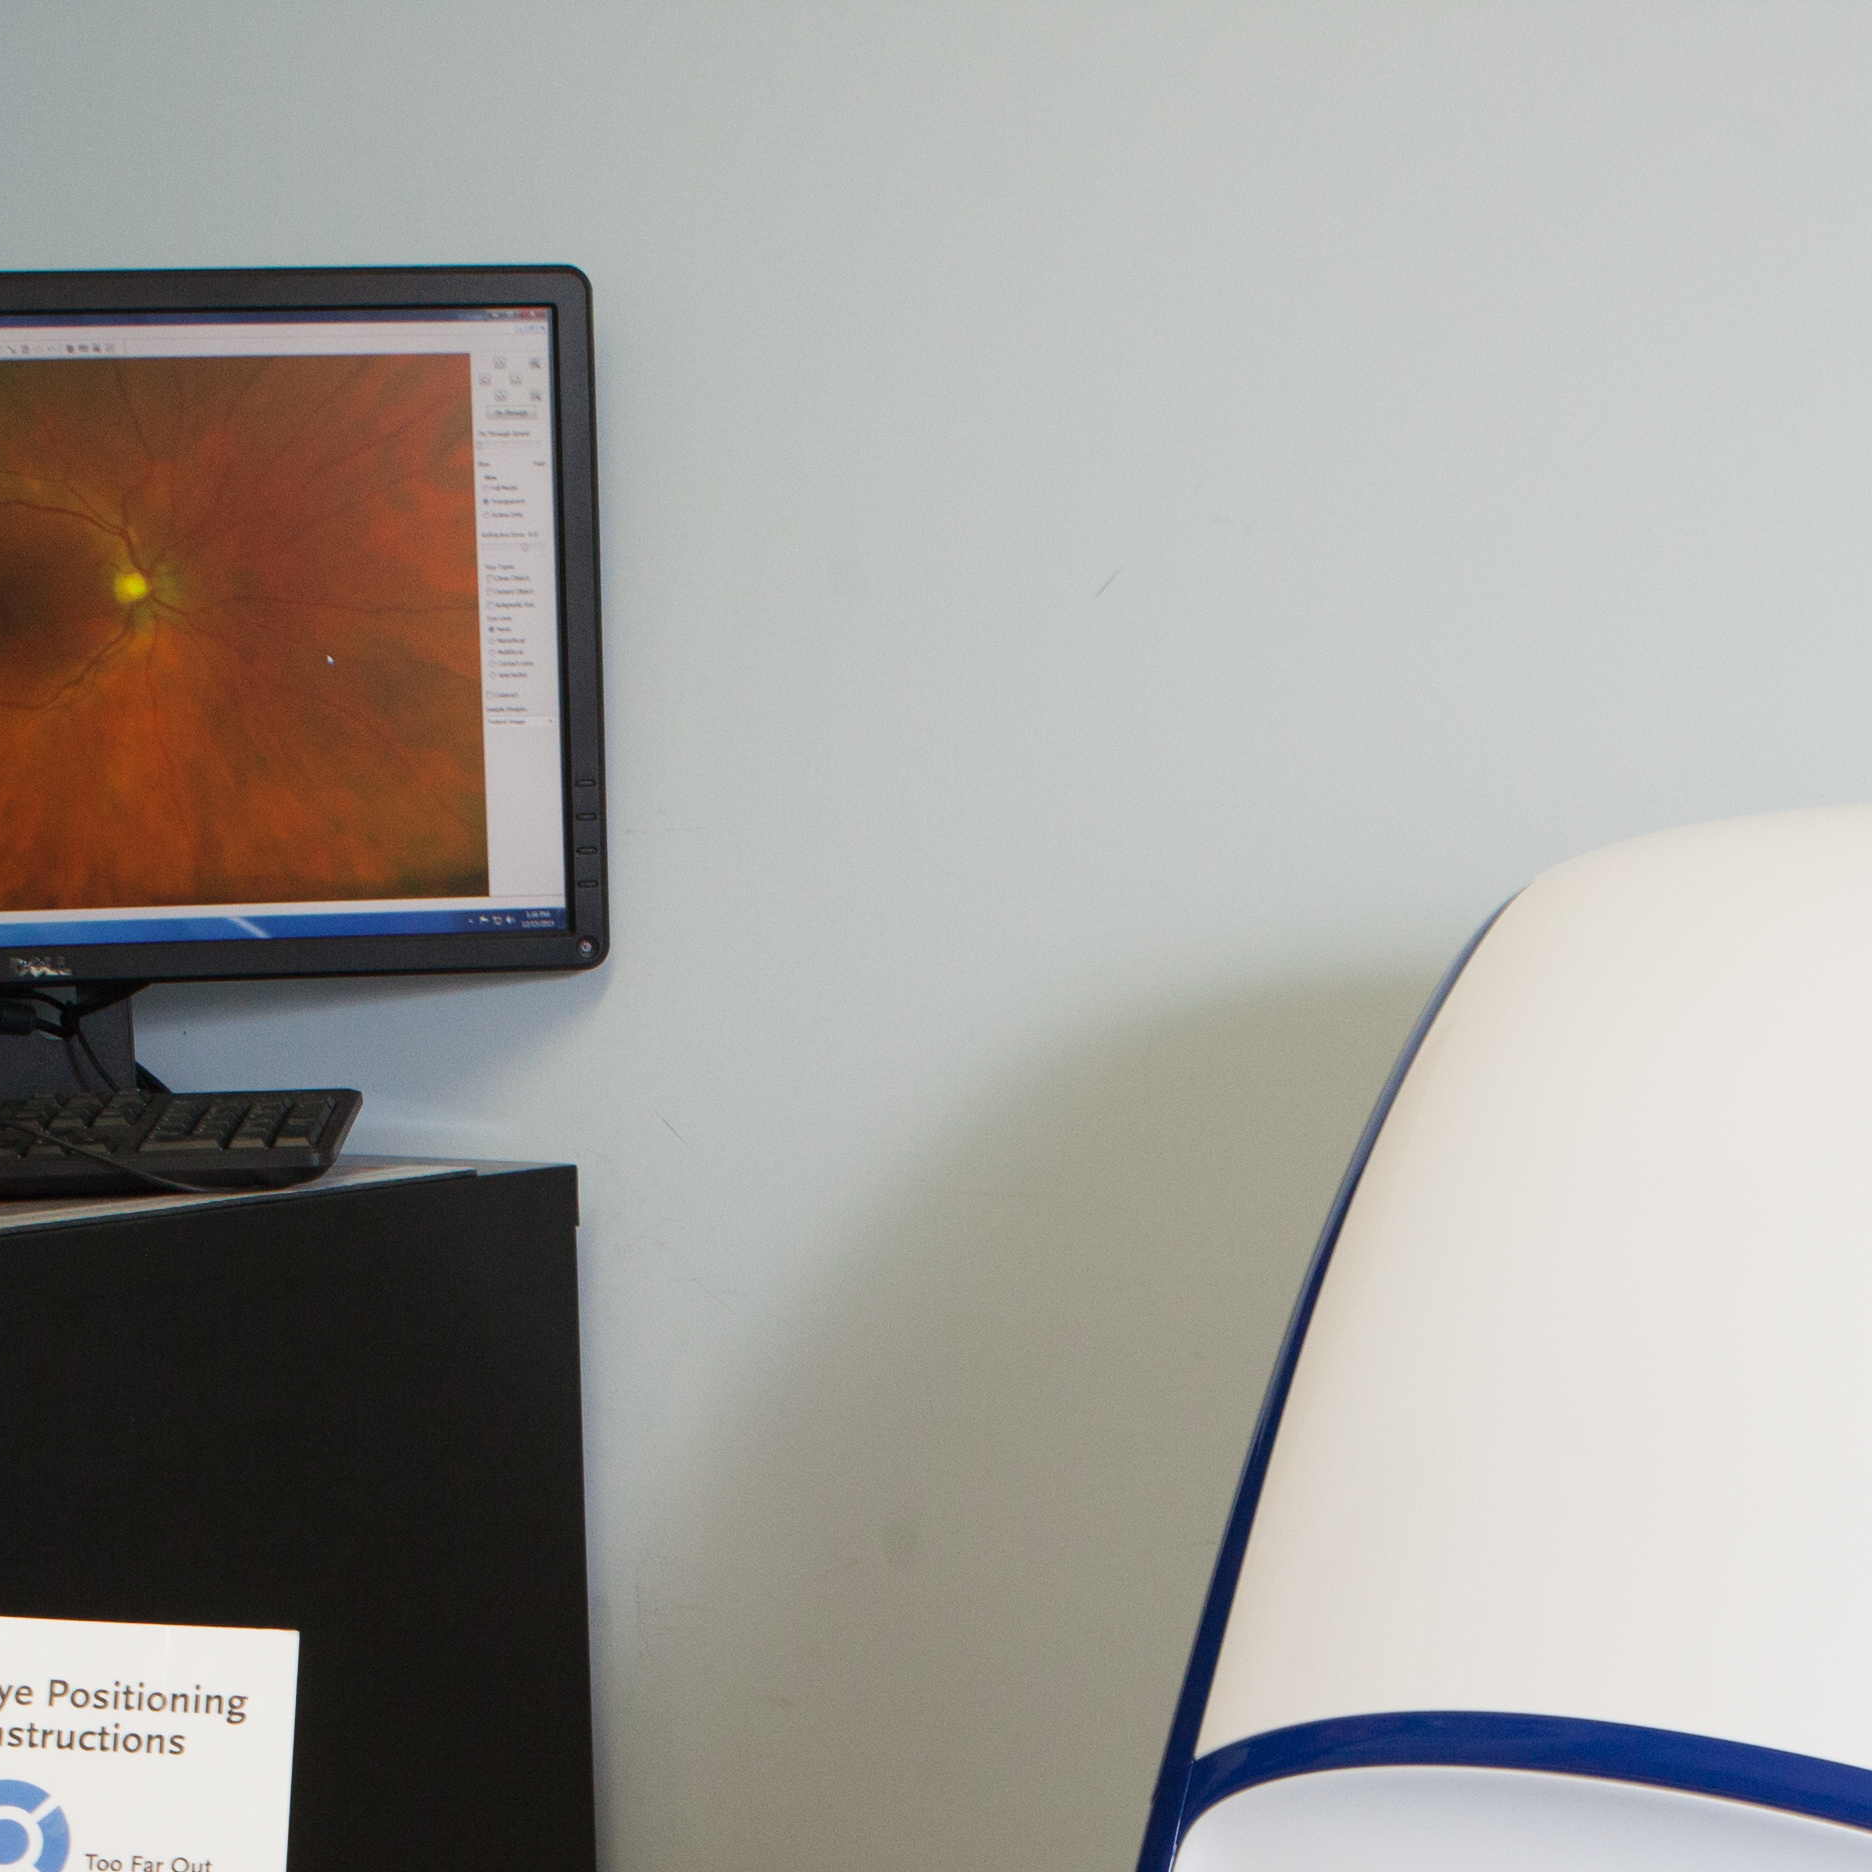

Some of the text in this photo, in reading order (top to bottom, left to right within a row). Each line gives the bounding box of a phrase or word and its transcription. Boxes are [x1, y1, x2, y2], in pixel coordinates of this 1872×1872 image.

[48, 1679, 249, 1725] Positioning
[85, 1854, 123, 1872] Too
[132, 1855, 164, 1872] Far
